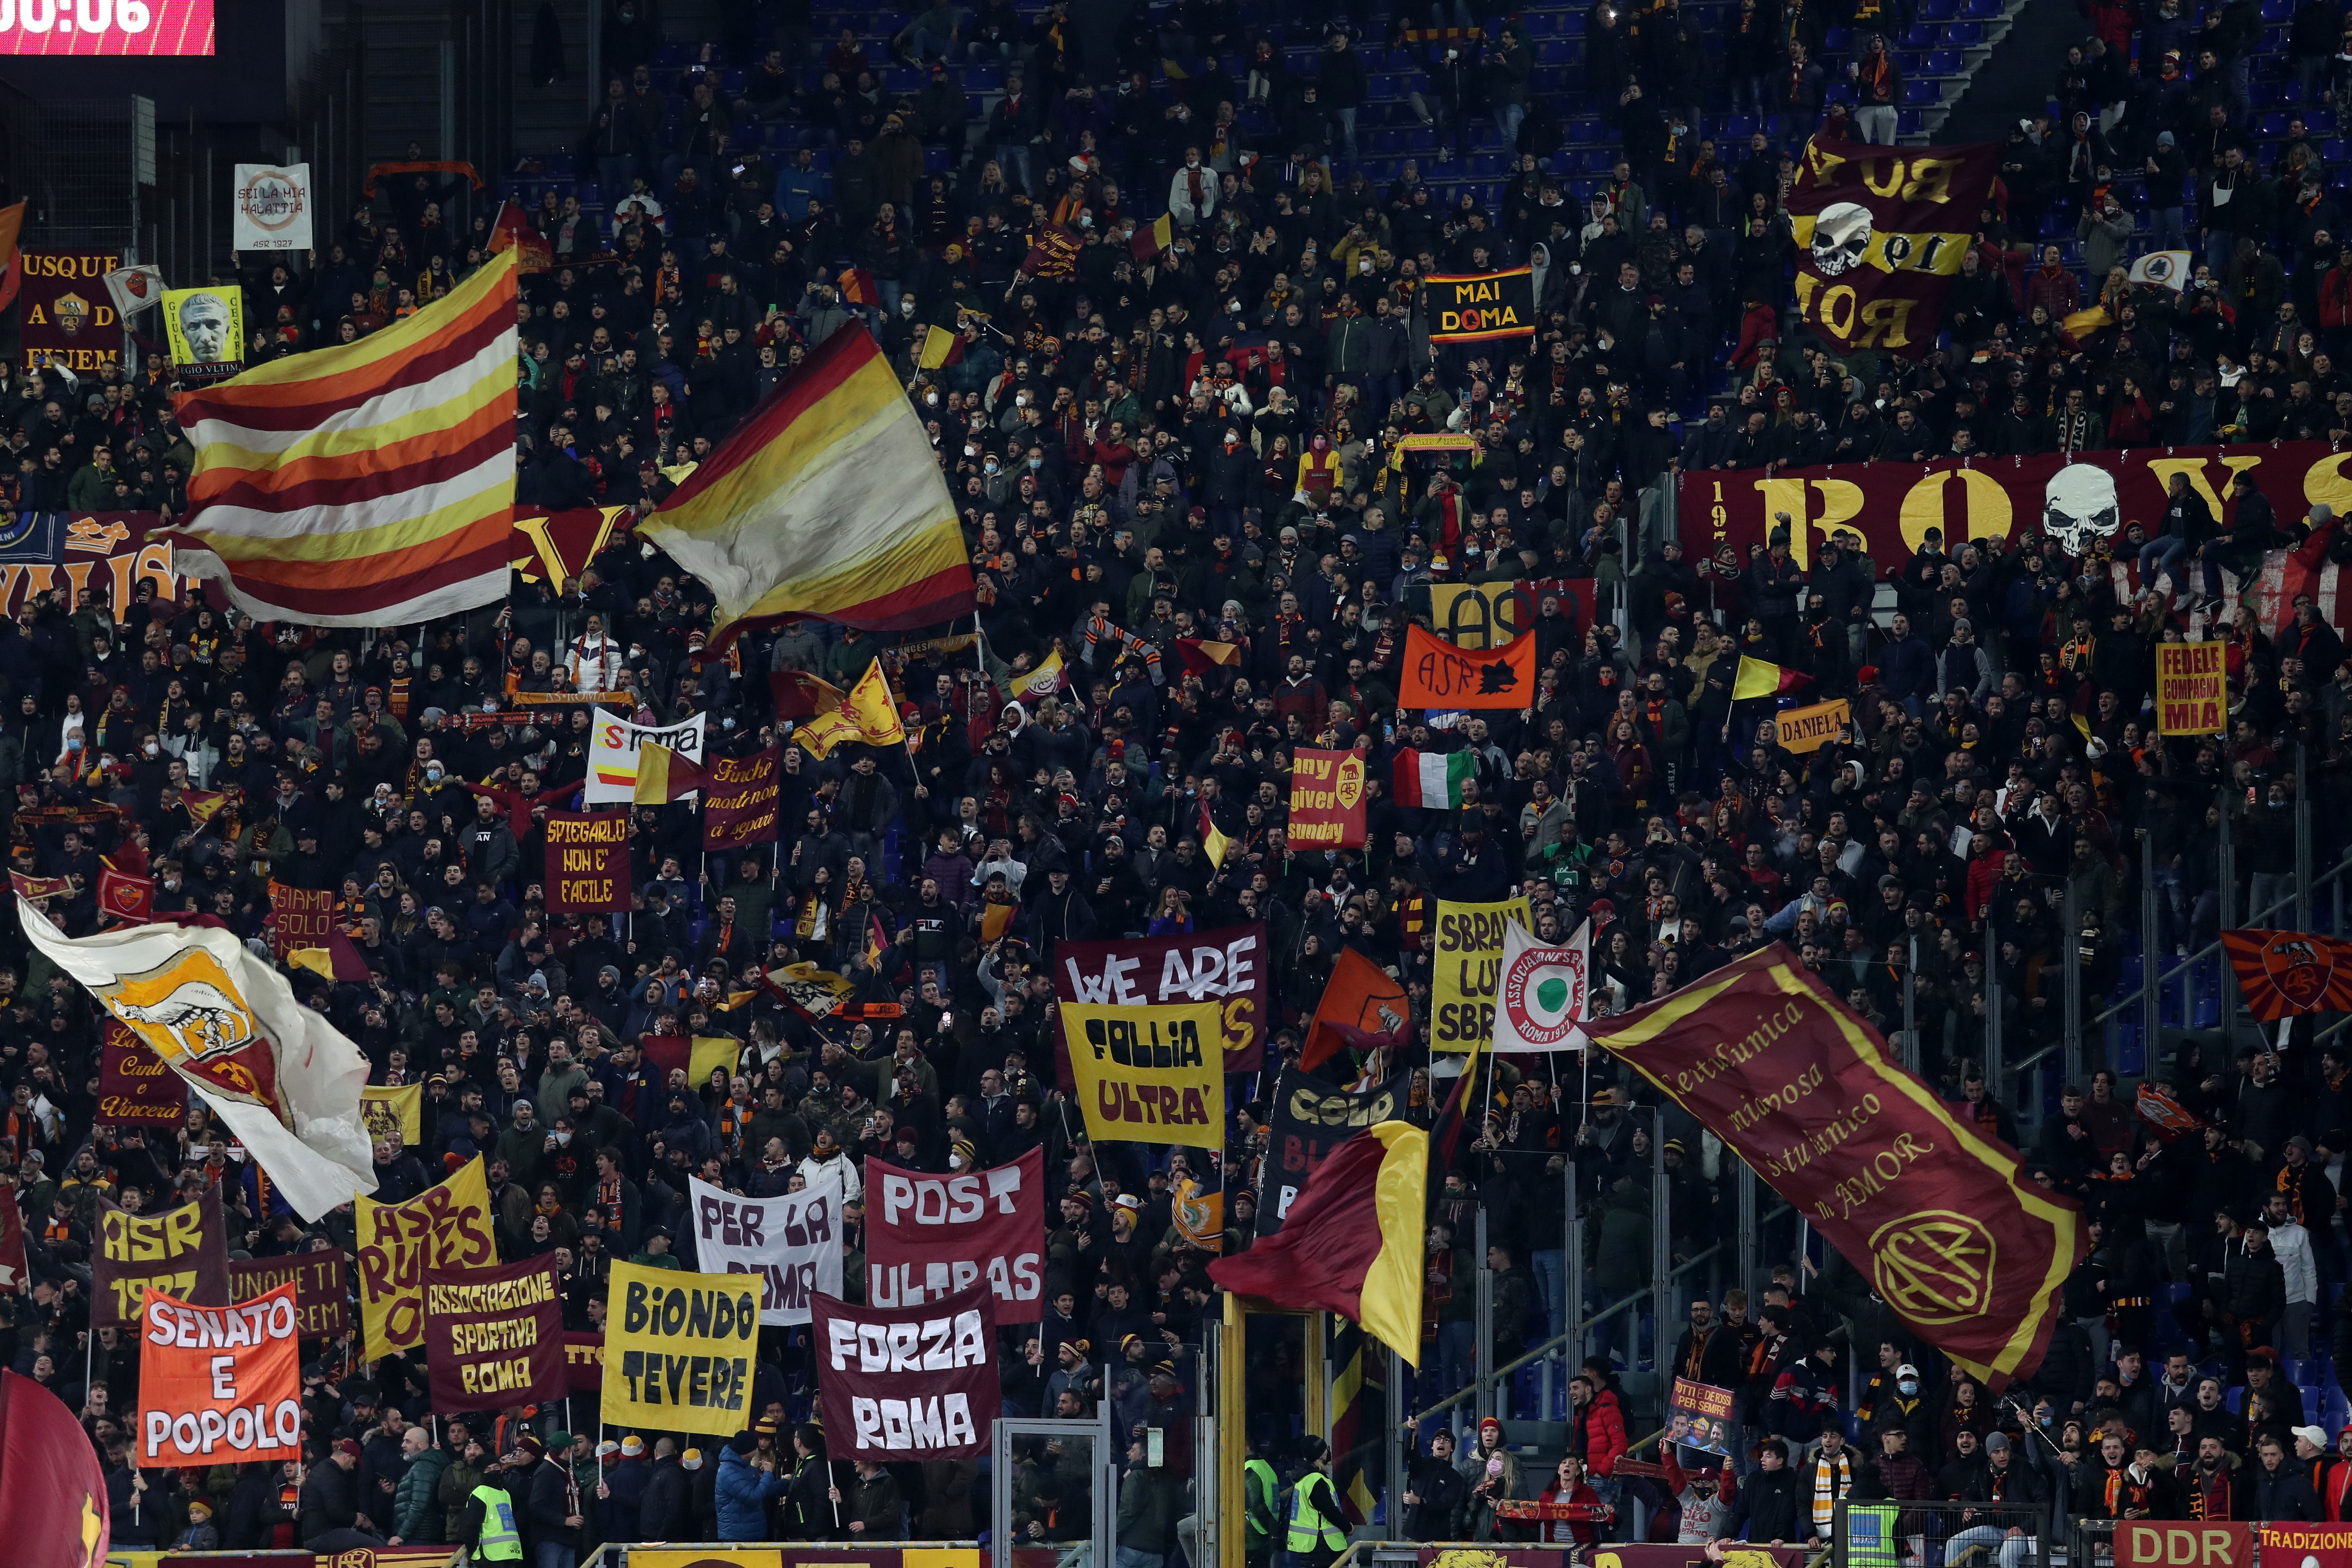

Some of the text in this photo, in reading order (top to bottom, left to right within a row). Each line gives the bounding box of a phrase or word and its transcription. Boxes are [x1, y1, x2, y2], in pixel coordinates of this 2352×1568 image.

[239, 187, 305, 199] SEI LA MIA
[241, 202, 303, 214] MALATTIA
[1456, 282, 1500, 304] MAI
[169, 302, 184, 364] GIULIO
[1418, 652, 1474, 696] ASR
[2163, 647, 2220, 675] FEDELE
[2163, 677, 2220, 700] COMPAGNA
[1782, 712, 1844, 742] DANIELA
[2164, 702, 2220, 730] MIA
[1294, 756, 1332, 780] any
[750, 784, 780, 805] non
[547, 818, 625, 843] SPIEGARLO
[1287, 821, 1344, 844] sunday
[564, 849, 591, 871] NON
[278, 888, 332, 911] SIAMO
[561, 879, 612, 903] FACILE
[277, 914, 329, 935] SOLO
[916, 919, 944, 932] FILA
[1065, 935, 1256, 1005] WE ARE
[107, 1028, 138, 1048] La
[1518, 1019, 1569, 1043] ROMA 1927
[137, 1083, 147, 1095] e
[101, 1095, 182, 1119] Vincerà
[1834, 1131, 1935, 1220] AMOR
[884, 1165, 1021, 1225] POST
[372, 1185, 452, 1246] ASR
[700, 1195, 831, 1246] PER LA
[102, 1200, 204, 1262] ASR
[314, 1261, 338, 1292] TI
[727, 1261, 817, 1310] OMA
[871, 1253, 1041, 1309] ULTRAS
[148, 1296, 296, 1349] SENATO
[827, 1309, 986, 1373] FORZA
[211, 1355, 238, 1400] E
[461, 1356, 532, 1394] ROMA
[1675, 1382, 1732, 1406] TOTTI E DE ROSSI
[1678, 1394, 1725, 1417] PER SEMPRE
[146, 1400, 301, 1458] POPOLO
[851, 1392, 977, 1450] ROMA
[1551, 1508, 1570, 1519] 10
[1684, 1520, 1695, 1529] UN
[2132, 1527, 2233, 1566] DDR
